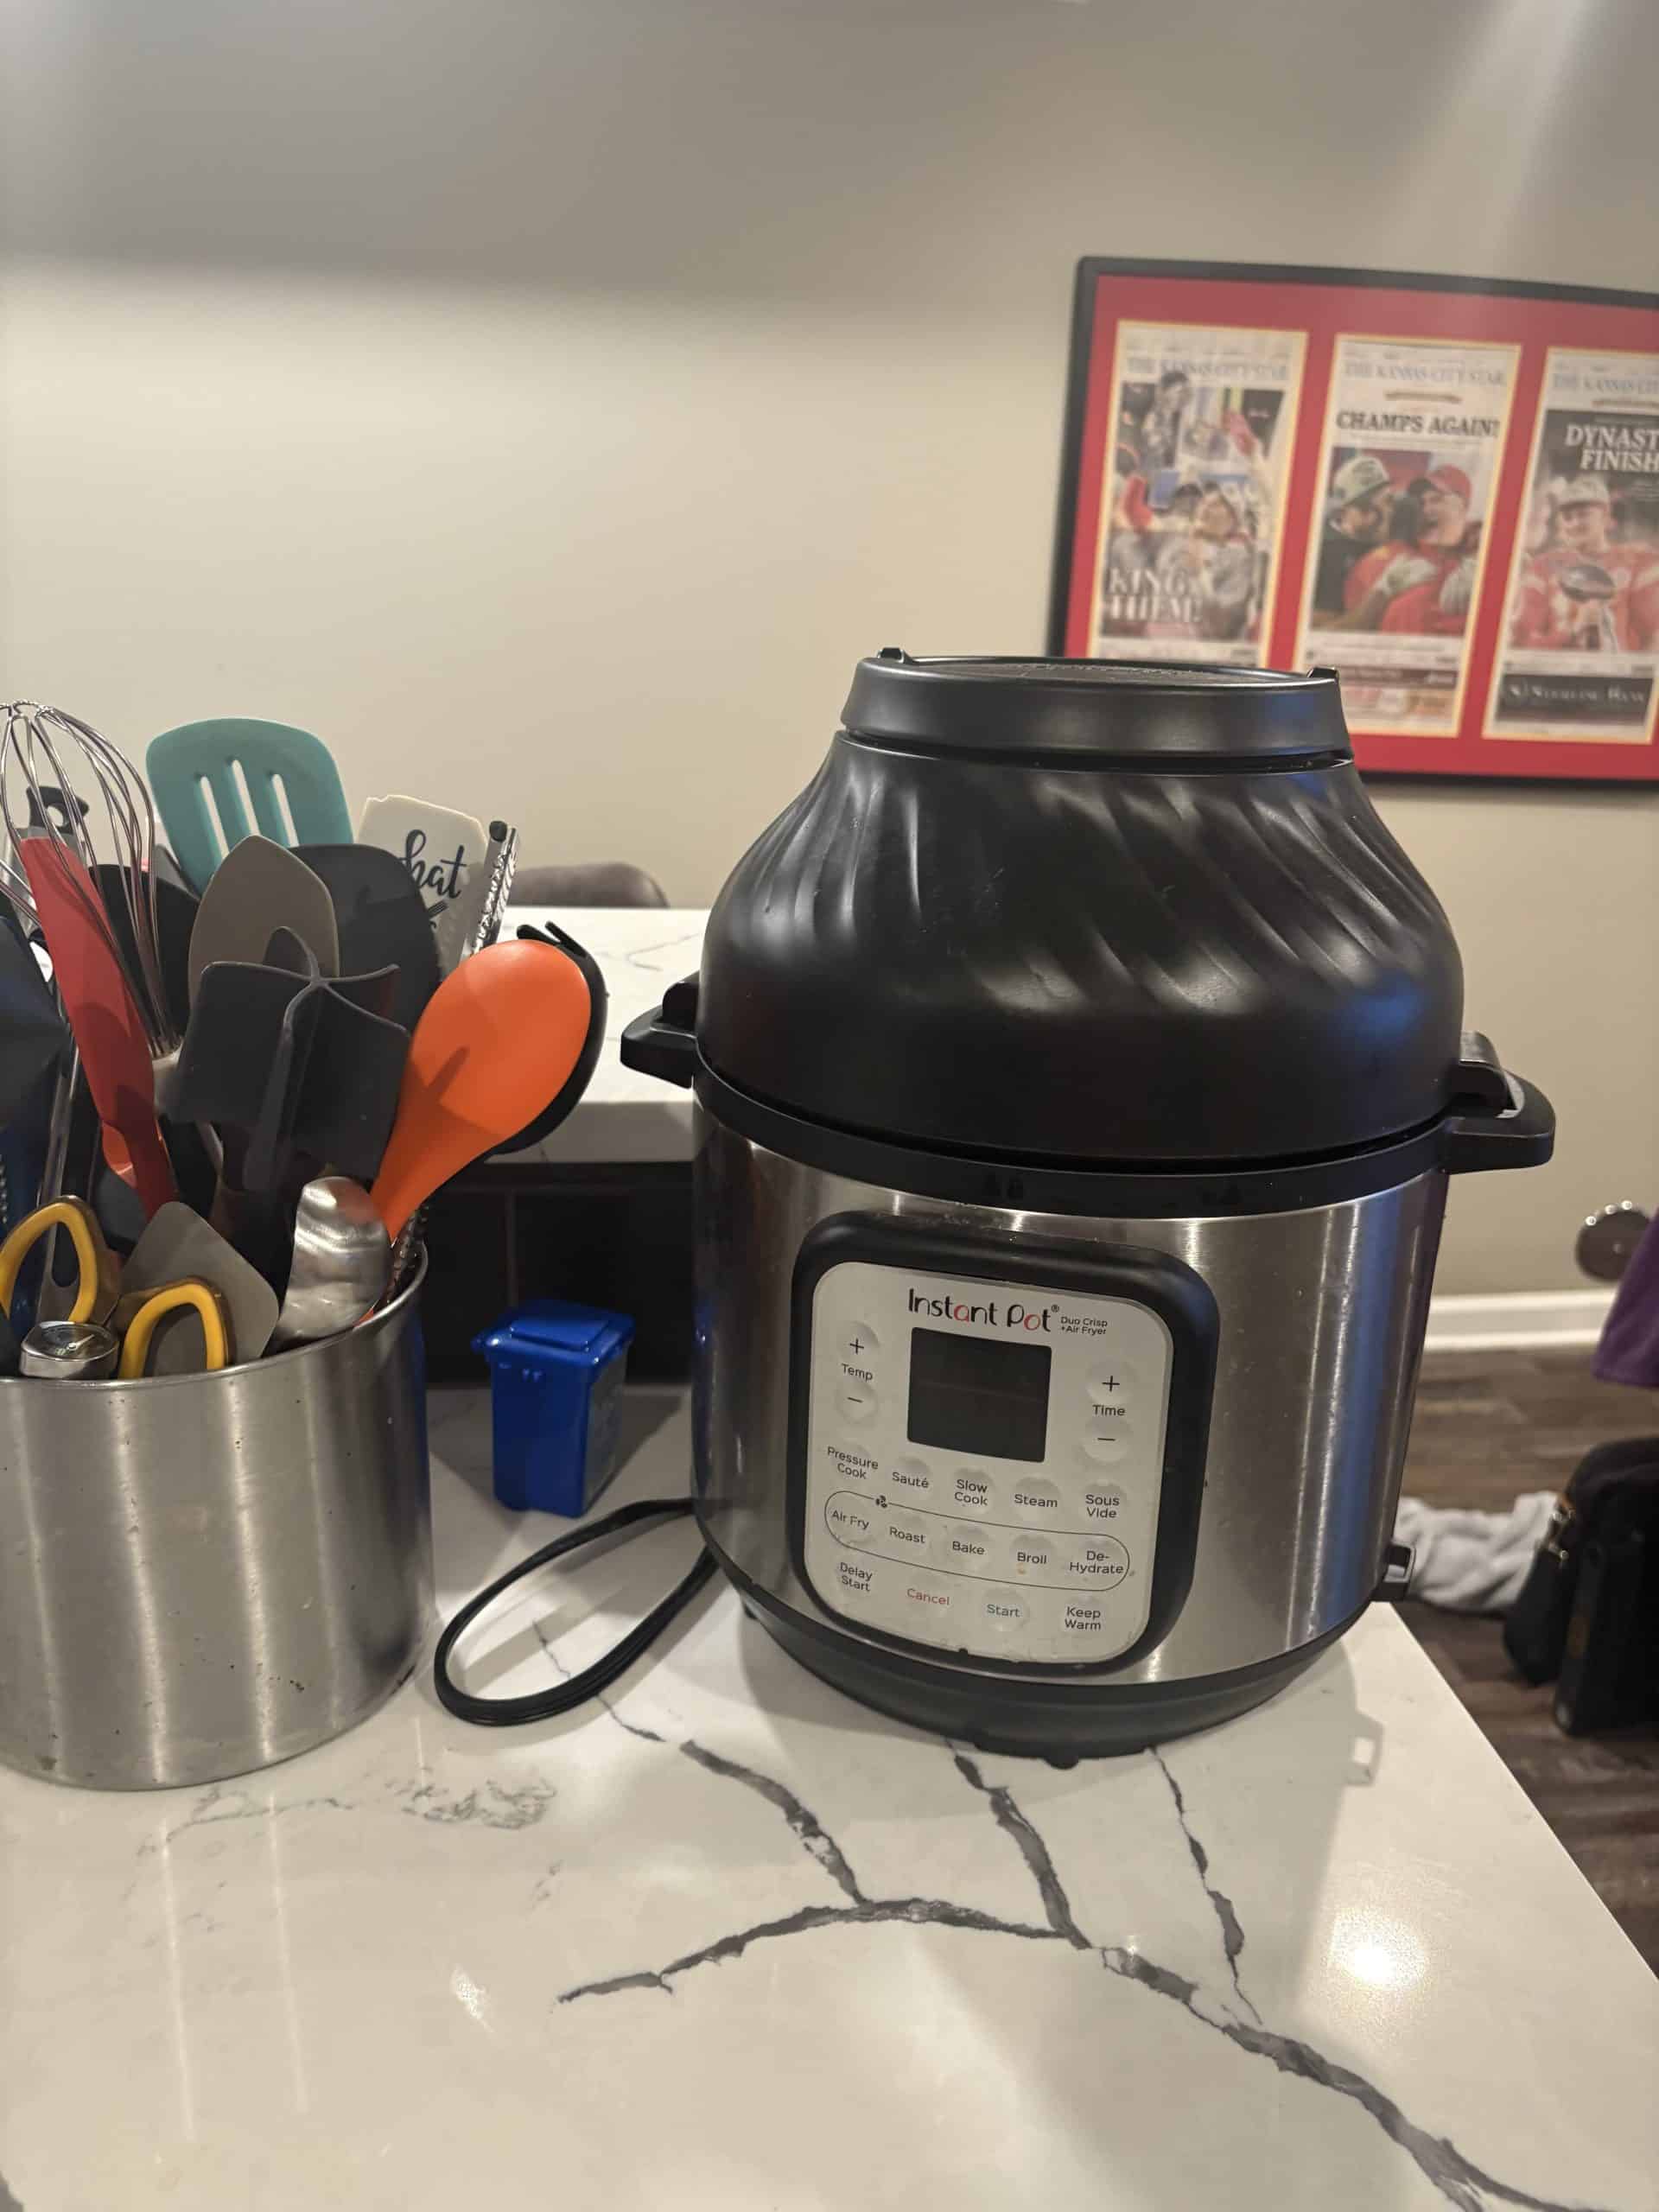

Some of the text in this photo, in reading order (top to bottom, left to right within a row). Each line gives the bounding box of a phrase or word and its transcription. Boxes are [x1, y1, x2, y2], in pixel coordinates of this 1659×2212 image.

[1336, 410, 1423, 432] CHAMPS
[398, 829, 467, 899] hat
[908, 1288, 997, 1325] Instant
[1060, 1316, 1108, 1328] Duo Crisp
[1082, 1325, 1107, 1336] Fryer
[841, 1363, 873, 1382] Temp
[1092, 1405, 1126, 1417] Time
[827, 1446, 879, 1470] Pressure
[837, 1463, 867, 1479] Cook
[892, 1471, 929, 1489] Sauté
[956, 1478, 988, 1493] Slow
[954, 1491, 988, 1506] Cook
[1014, 1494, 1058, 1508] Steam
[1085, 1494, 1120, 1506] Sous
[831, 1510, 869, 1529] Air Fry
[1086, 1506, 1117, 1518] Vide
[890, 1527, 925, 1543] Roast
[952, 1541, 985, 1555] Bake
[1017, 1552, 1047, 1565] Broil
[840, 1561, 873, 1581] Delay
[1069, 1561, 1124, 1574] Hydrate
[841, 1575, 871, 1592] Start
[907, 1588, 950, 1605] Cancel
[987, 1604, 1020, 1618] Start
[1066, 1606, 1101, 1618] Keep
[1065, 1618, 1102, 1630] Warm
